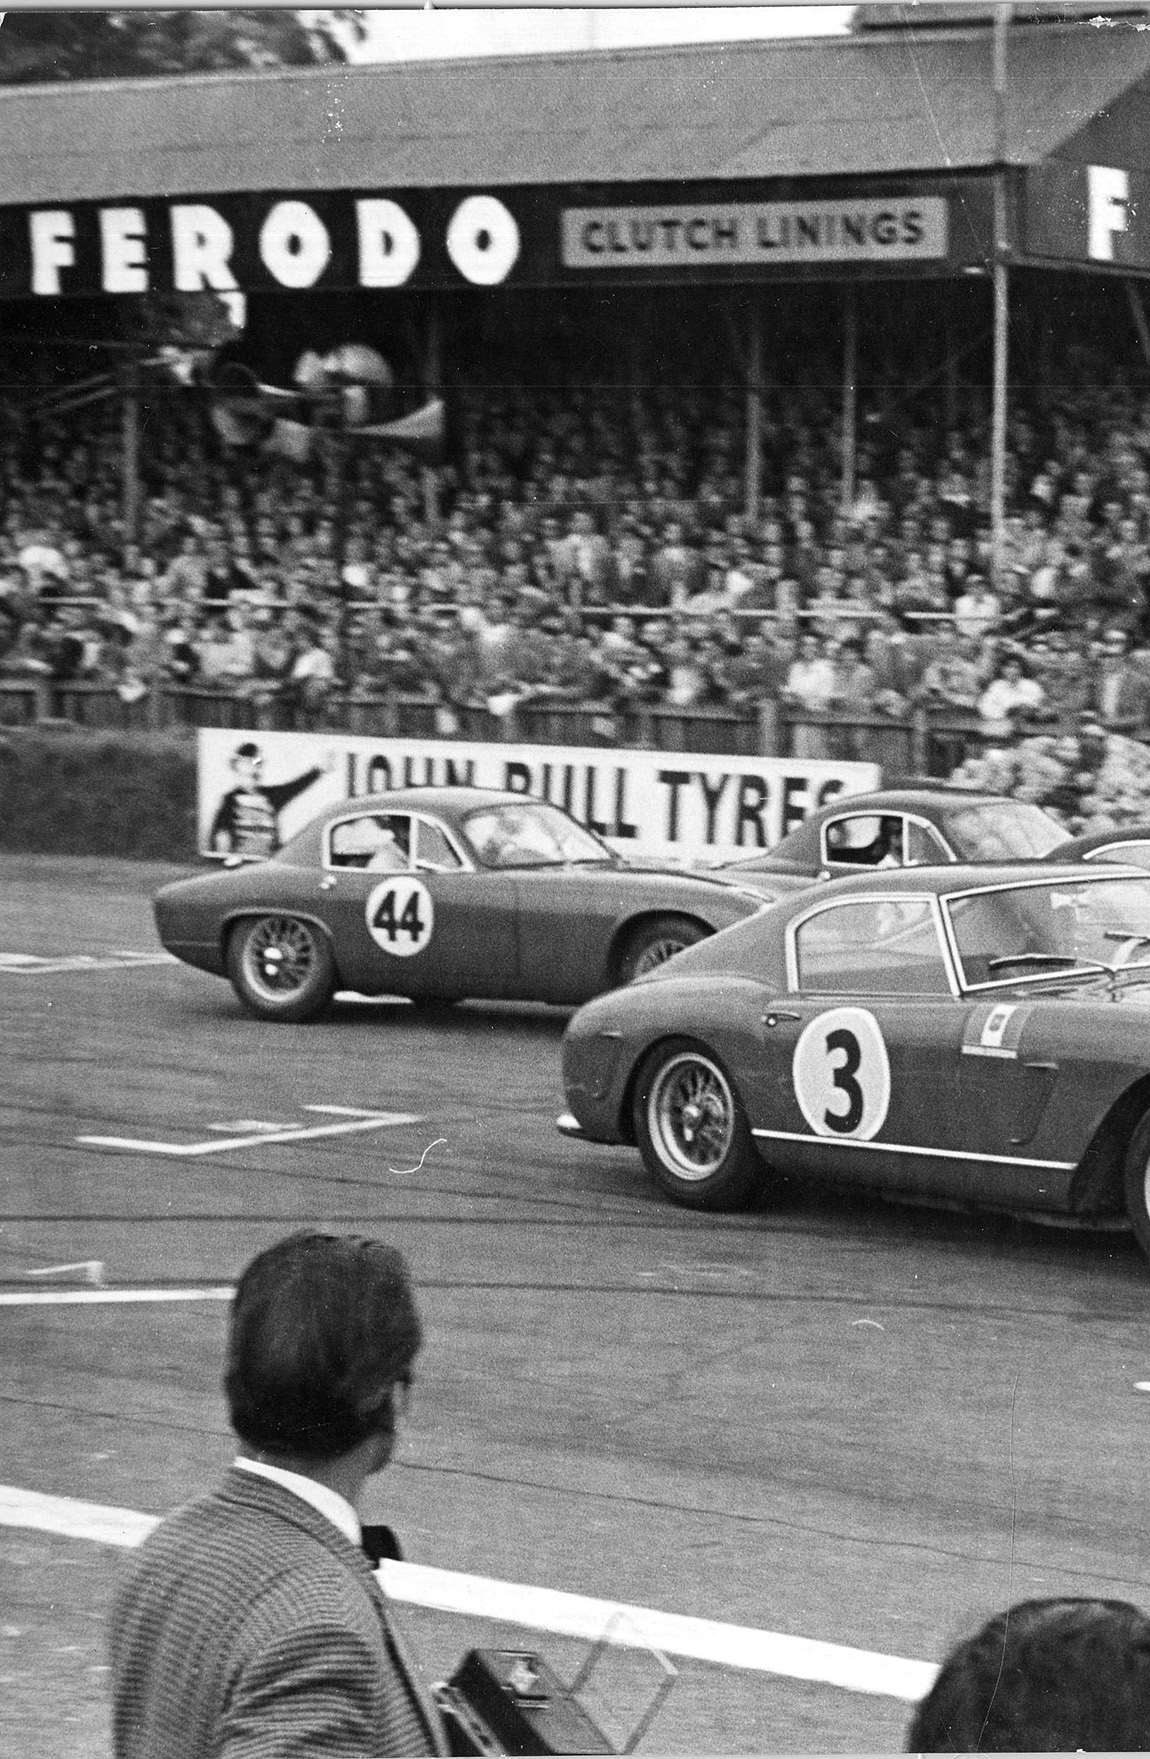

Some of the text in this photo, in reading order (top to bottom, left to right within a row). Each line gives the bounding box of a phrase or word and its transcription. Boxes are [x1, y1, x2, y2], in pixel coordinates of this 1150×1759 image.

[29, 195, 520, 295] FERODO
[581, 210, 924, 253] CLUTCH LININGS
[373, 890, 424, 943] 44
[823, 1028, 864, 1134] 3
